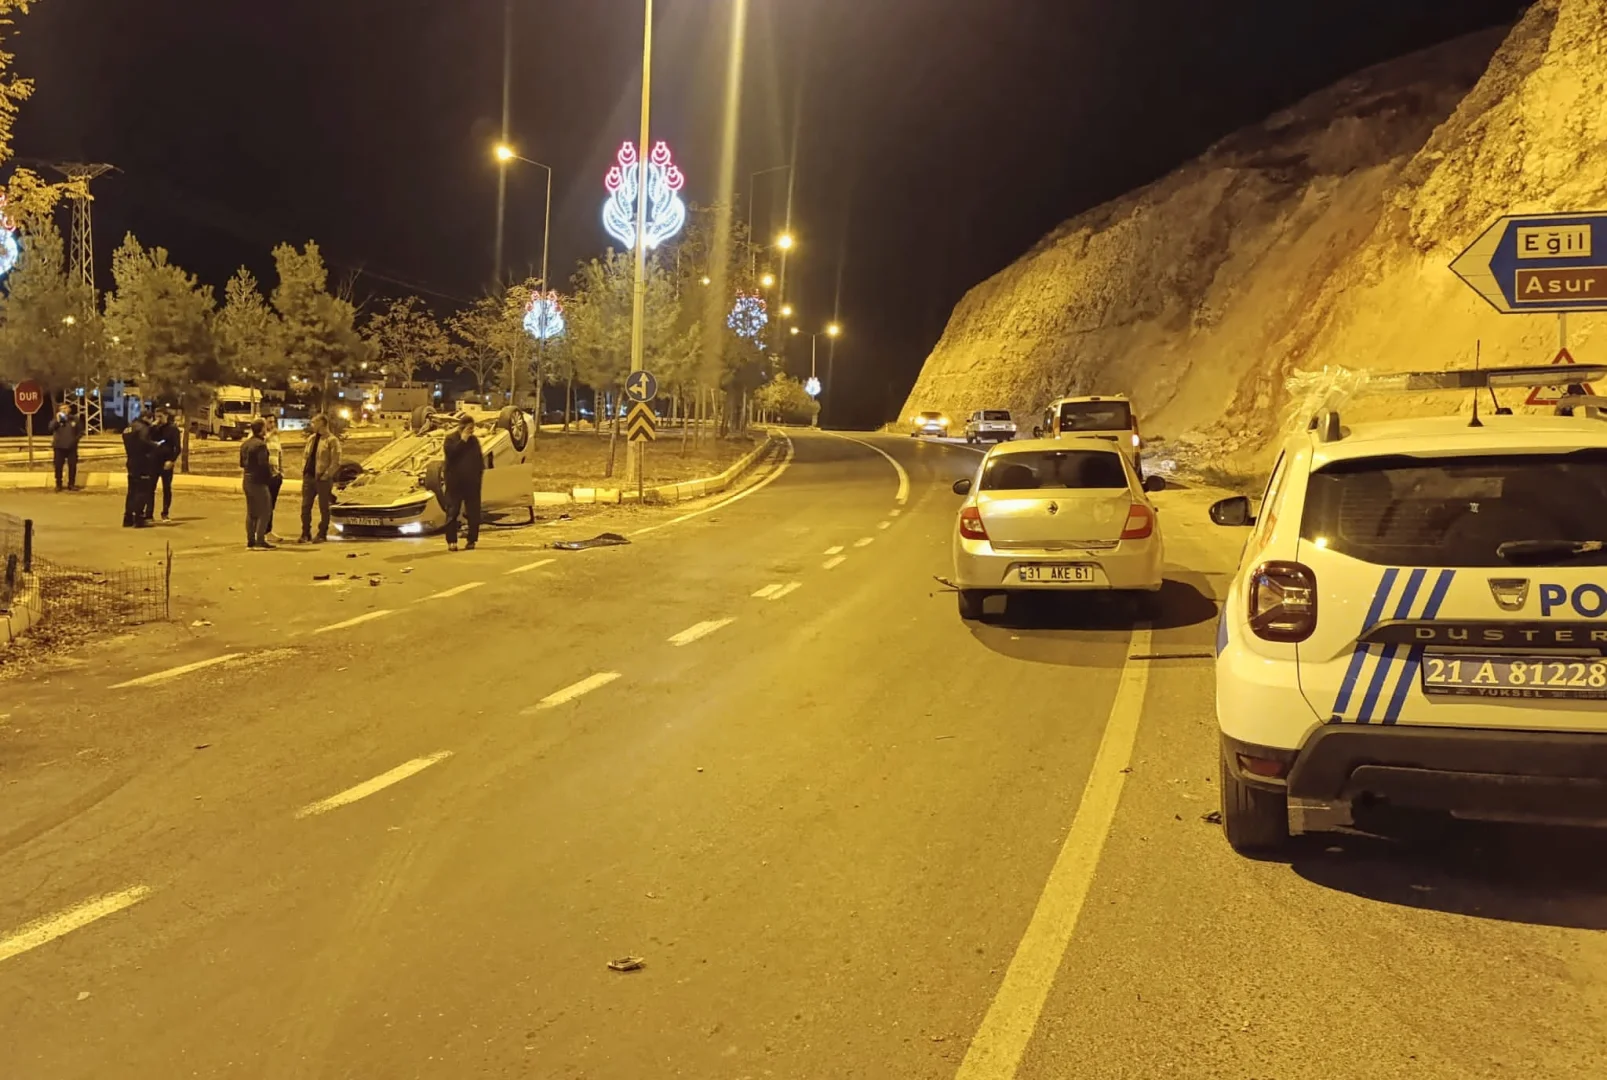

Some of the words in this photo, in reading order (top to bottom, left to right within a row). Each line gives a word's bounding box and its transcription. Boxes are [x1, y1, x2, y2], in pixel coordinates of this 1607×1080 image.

[1525, 232, 1583, 255] Eğil
[1524, 275, 1596, 294] Asur
[19, 391, 38, 402] DUR
[1027, 566, 1041, 579] 31
[1051, 566, 1071, 579] AKE
[1075, 567, 1088, 579] 61
[1415, 627, 1607, 642] DUSTER
[1426, 658, 1463, 683] 21
[1471, 659, 1499, 684] A
[1508, 660, 1607, 688] 81228
